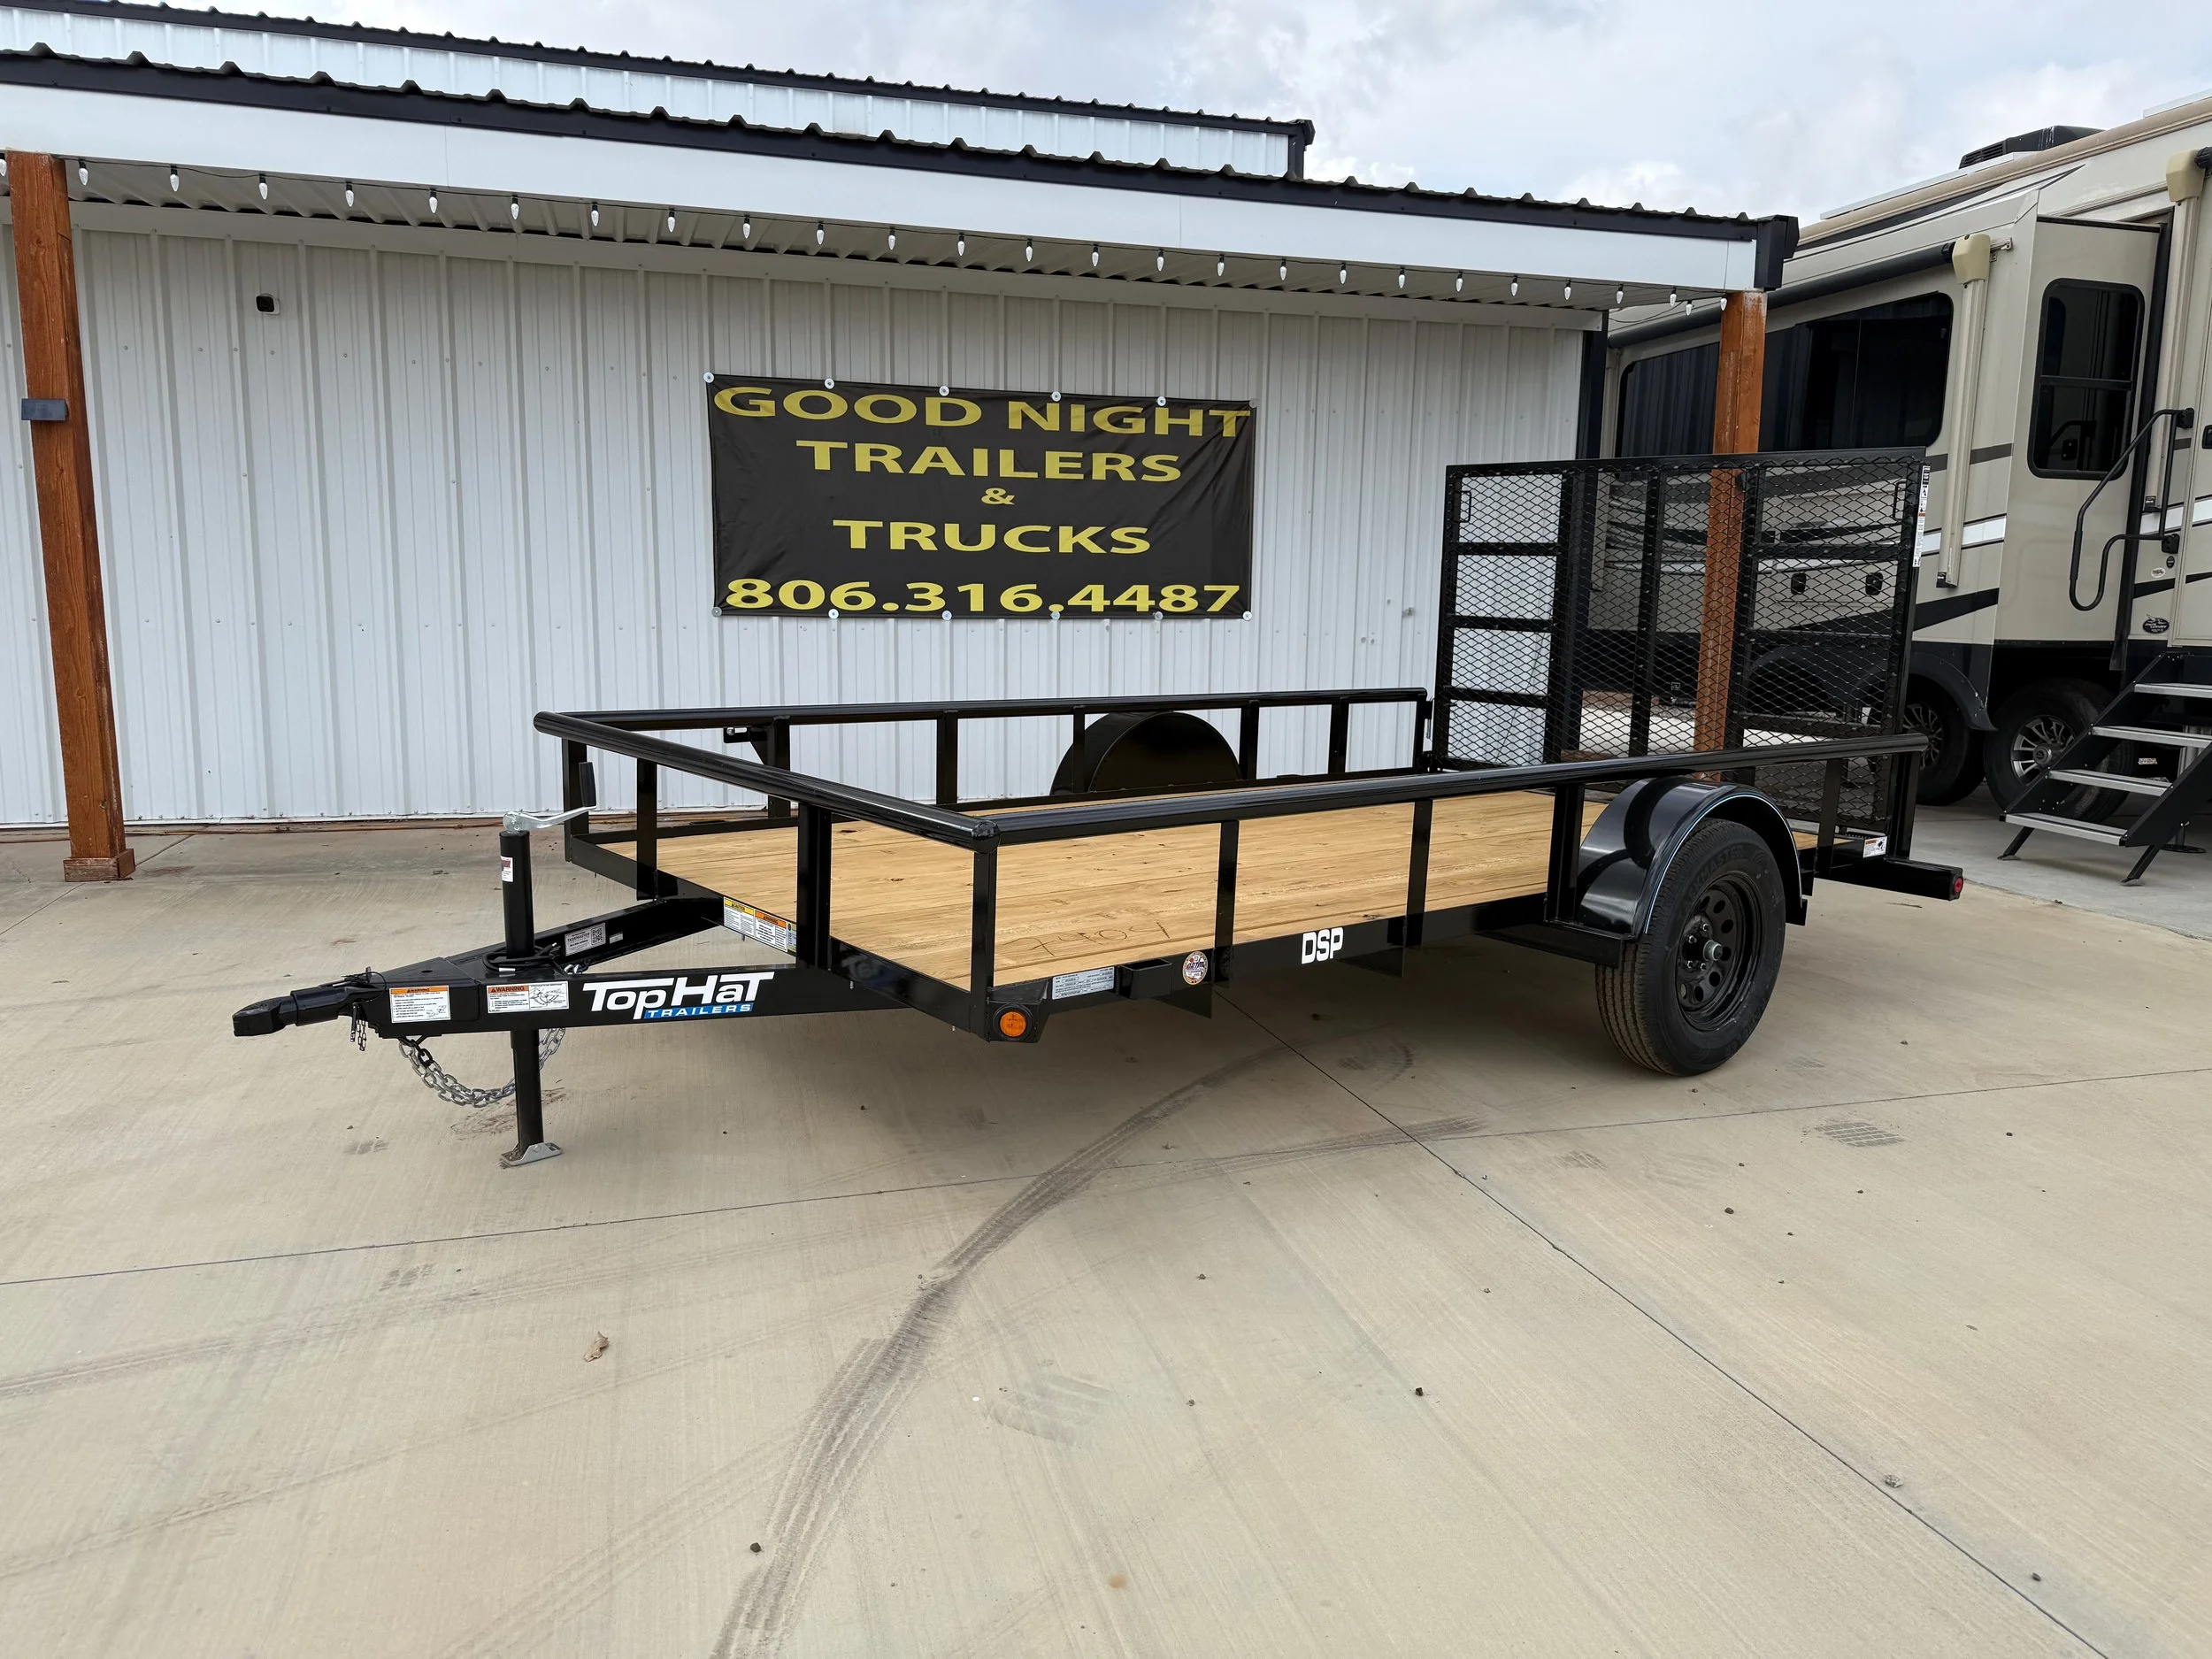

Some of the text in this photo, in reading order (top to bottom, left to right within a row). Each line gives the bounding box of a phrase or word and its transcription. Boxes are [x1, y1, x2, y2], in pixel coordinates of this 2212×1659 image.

[714, 387, 1251, 439] GOOD NIGHT
[796, 440, 1181, 482] TRAILERS
[981, 488, 1015, 505] &
[833, 519, 1151, 555] TRUCKS
[726, 578, 1240, 613] 806.316.4487
[1302, 927, 1343, 964] DSP
[648, 1003, 751, 1018] TRAILERS
